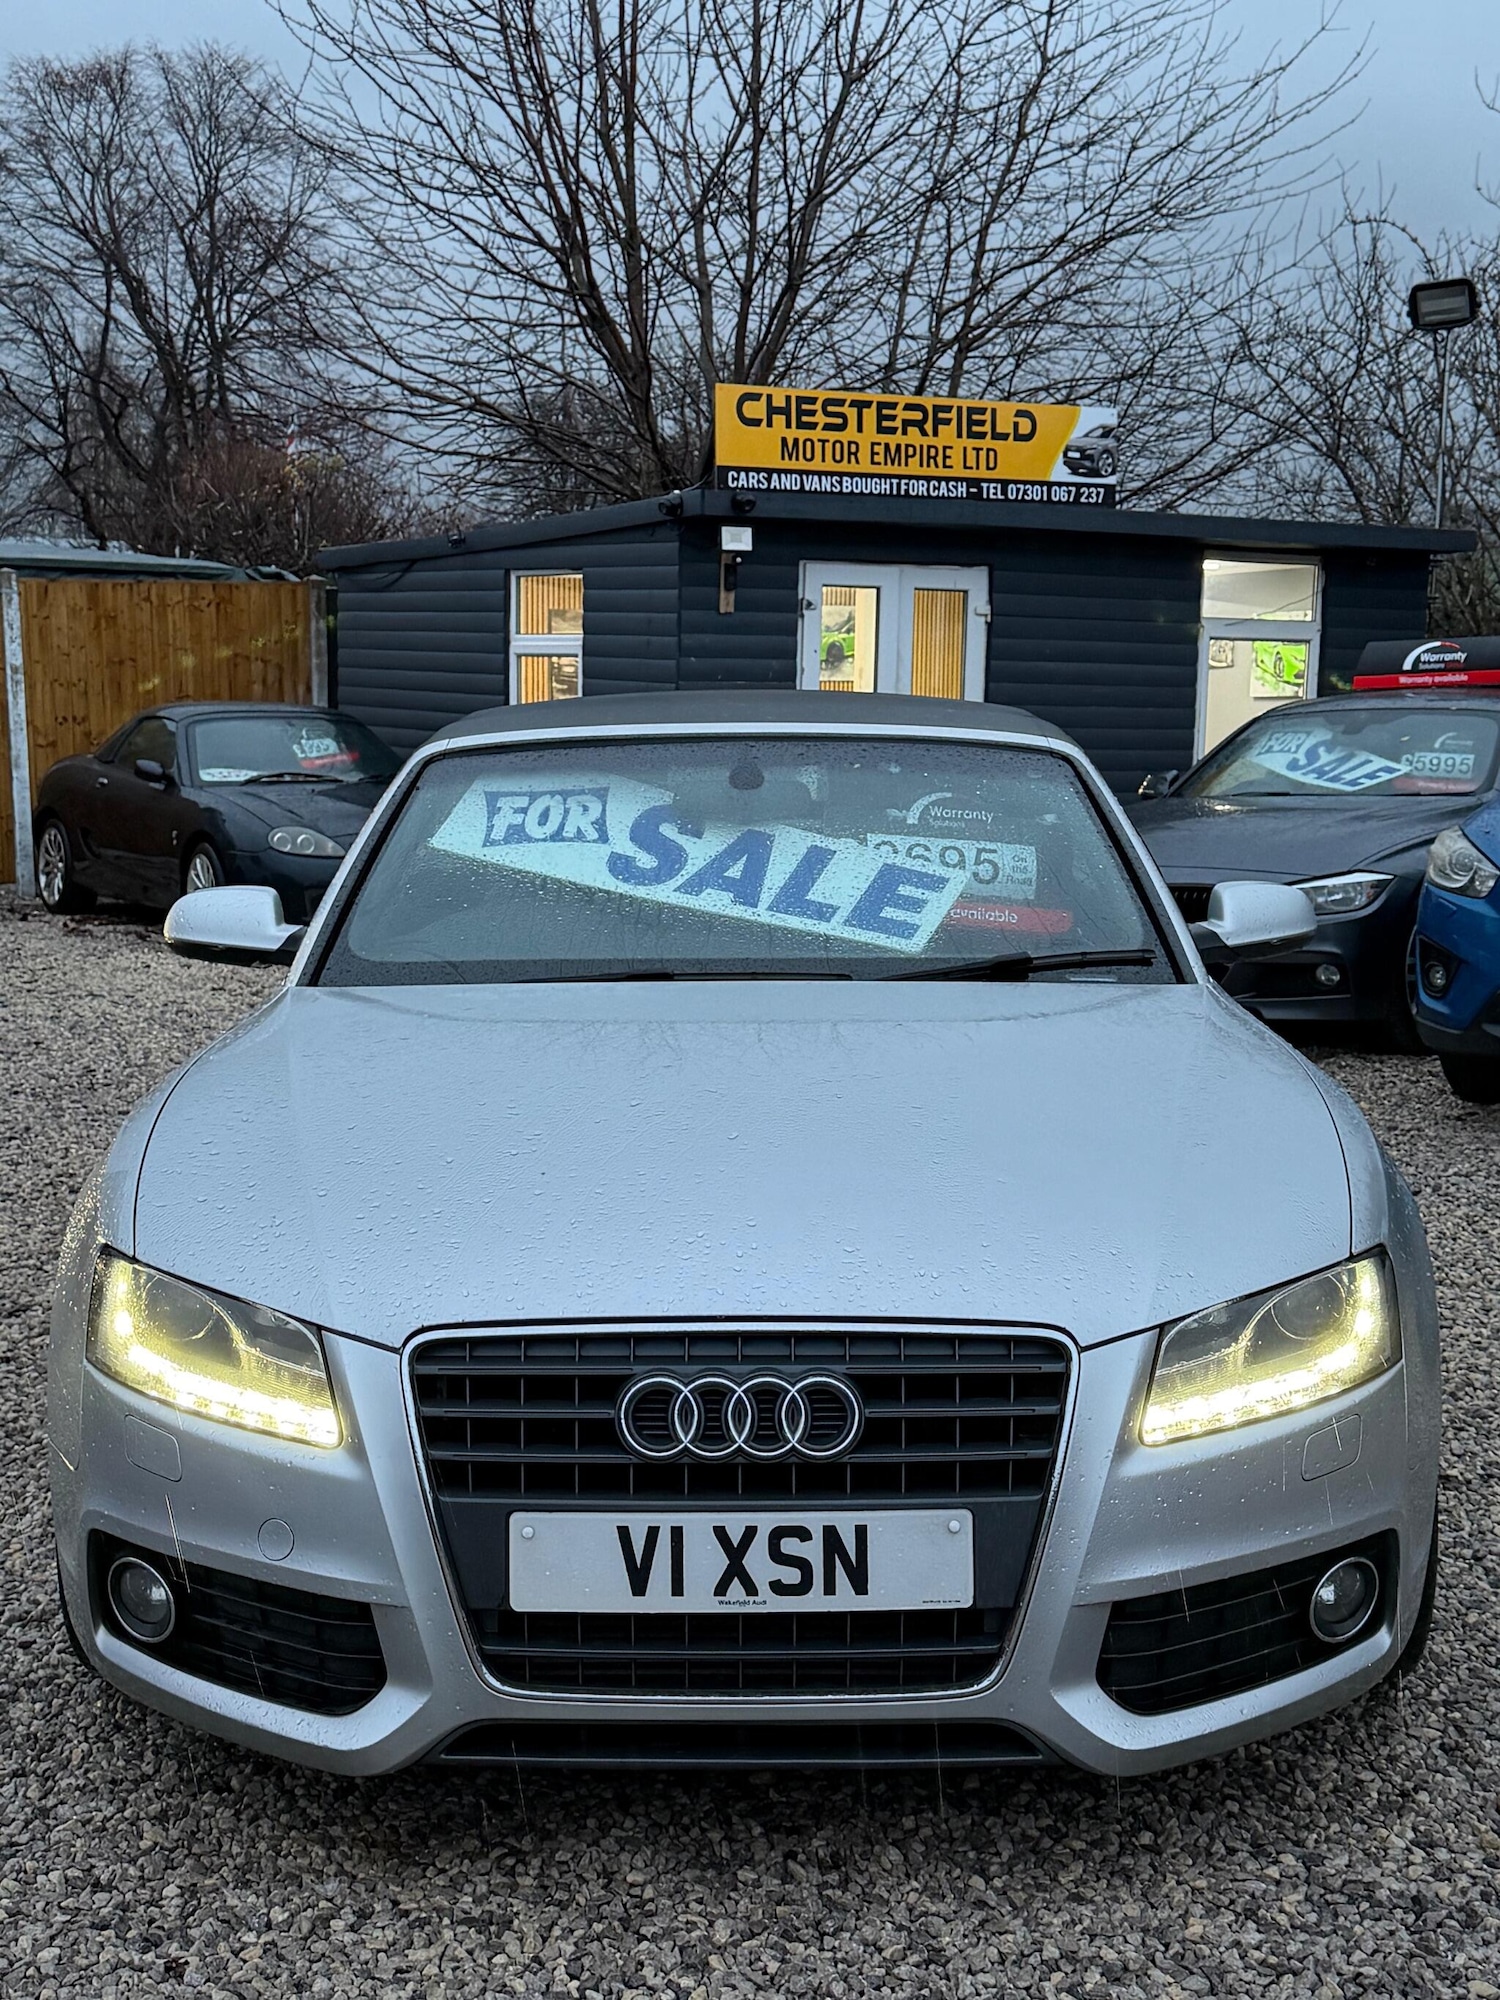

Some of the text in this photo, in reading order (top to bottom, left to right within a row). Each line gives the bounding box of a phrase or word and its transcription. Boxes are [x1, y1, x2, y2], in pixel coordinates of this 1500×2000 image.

[736, 392, 1037, 443] CHESTERFIELD
[780, 436, 998, 471] MOTOR EMPIRE LTD
[727, 470, 769, 490] CARS
[770, 474, 801, 491] AND
[802, 474, 842, 493] VANS
[842, 478, 901, 496] BOUGHT
[900, 479, 928, 497] FOR
[929, 481, 967, 499] CASH
[981, 482, 1005, 499] TEL
[1007, 483, 1048, 501] 07301
[1050, 487, 1076, 502] 067
[1079, 488, 1105, 504] 237
[1420, 651, 1468, 663] Warranty
[1398, 673, 1469, 685] Warranty available
[1262, 732, 1401, 788] FOR SALE
[929, 805, 994, 824] Warranty
[490, 794, 950, 941] FOR SALE
[1012, 854, 1028, 864] On
[950, 907, 1019, 924] available
[712, 1524, 869, 1597] XSN
